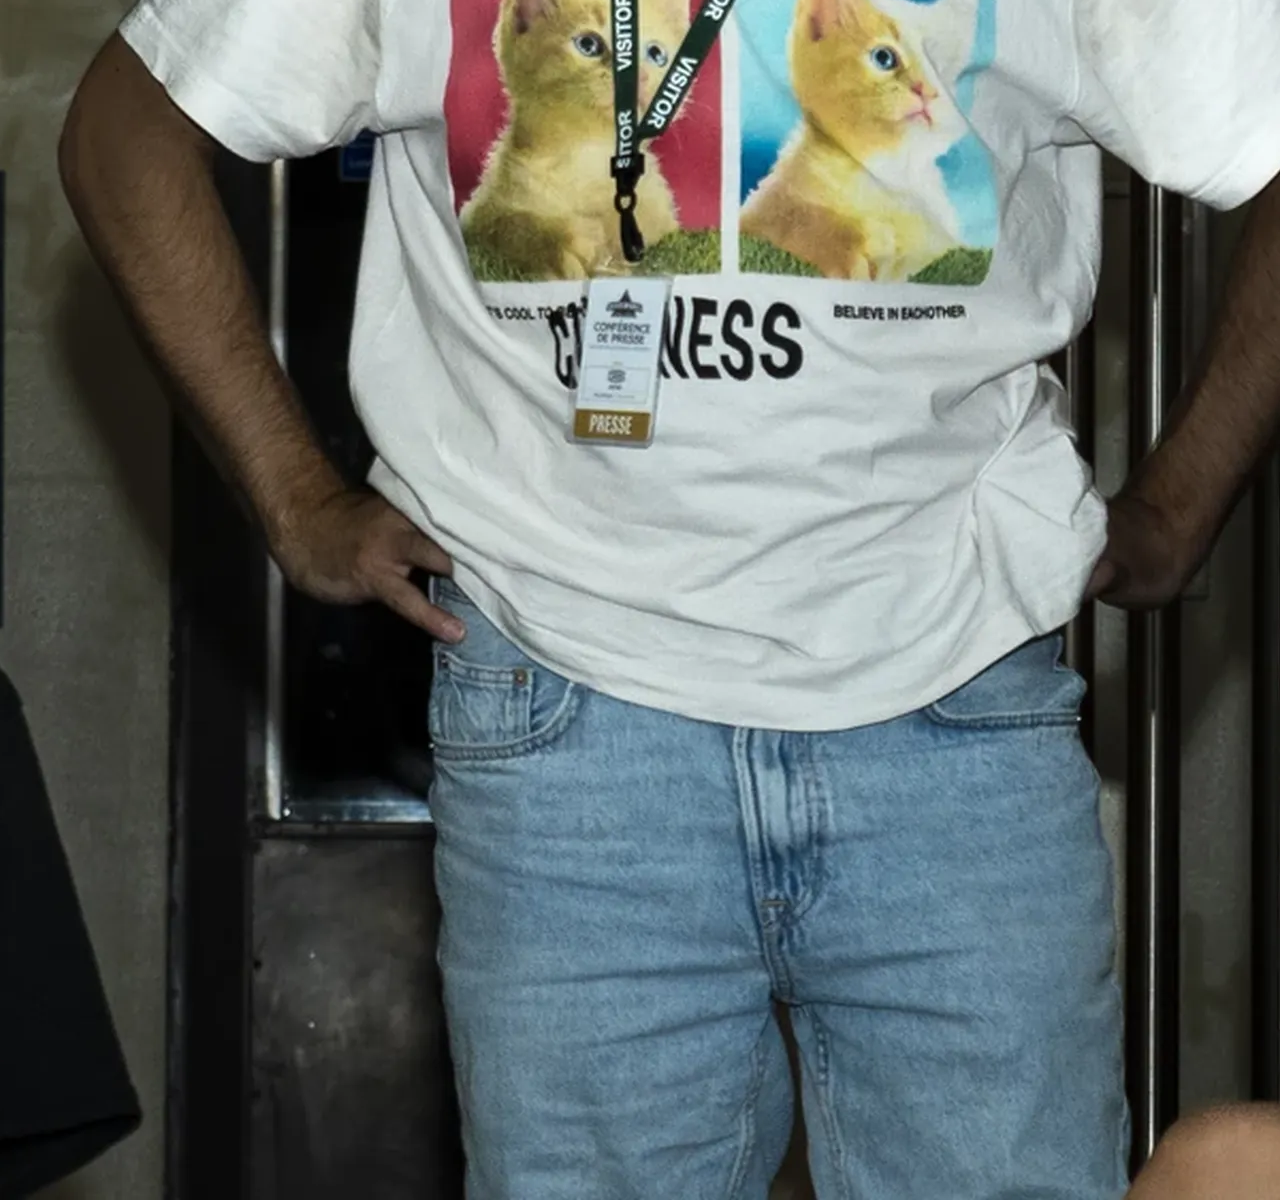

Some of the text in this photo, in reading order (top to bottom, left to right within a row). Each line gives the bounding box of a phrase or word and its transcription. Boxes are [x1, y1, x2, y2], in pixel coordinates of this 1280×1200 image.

[647, 56, 698, 130] VISITOR
[615, 109, 633, 169] SITOR
[504, 306, 536, 320] COOL
[833, 304, 967, 320] BELIEVE IN EACHOTHER
[548, 296, 804, 390] CNESS
[597, 334, 646, 345] DE PRESSE
[588, 413, 634, 435] PRESSE
